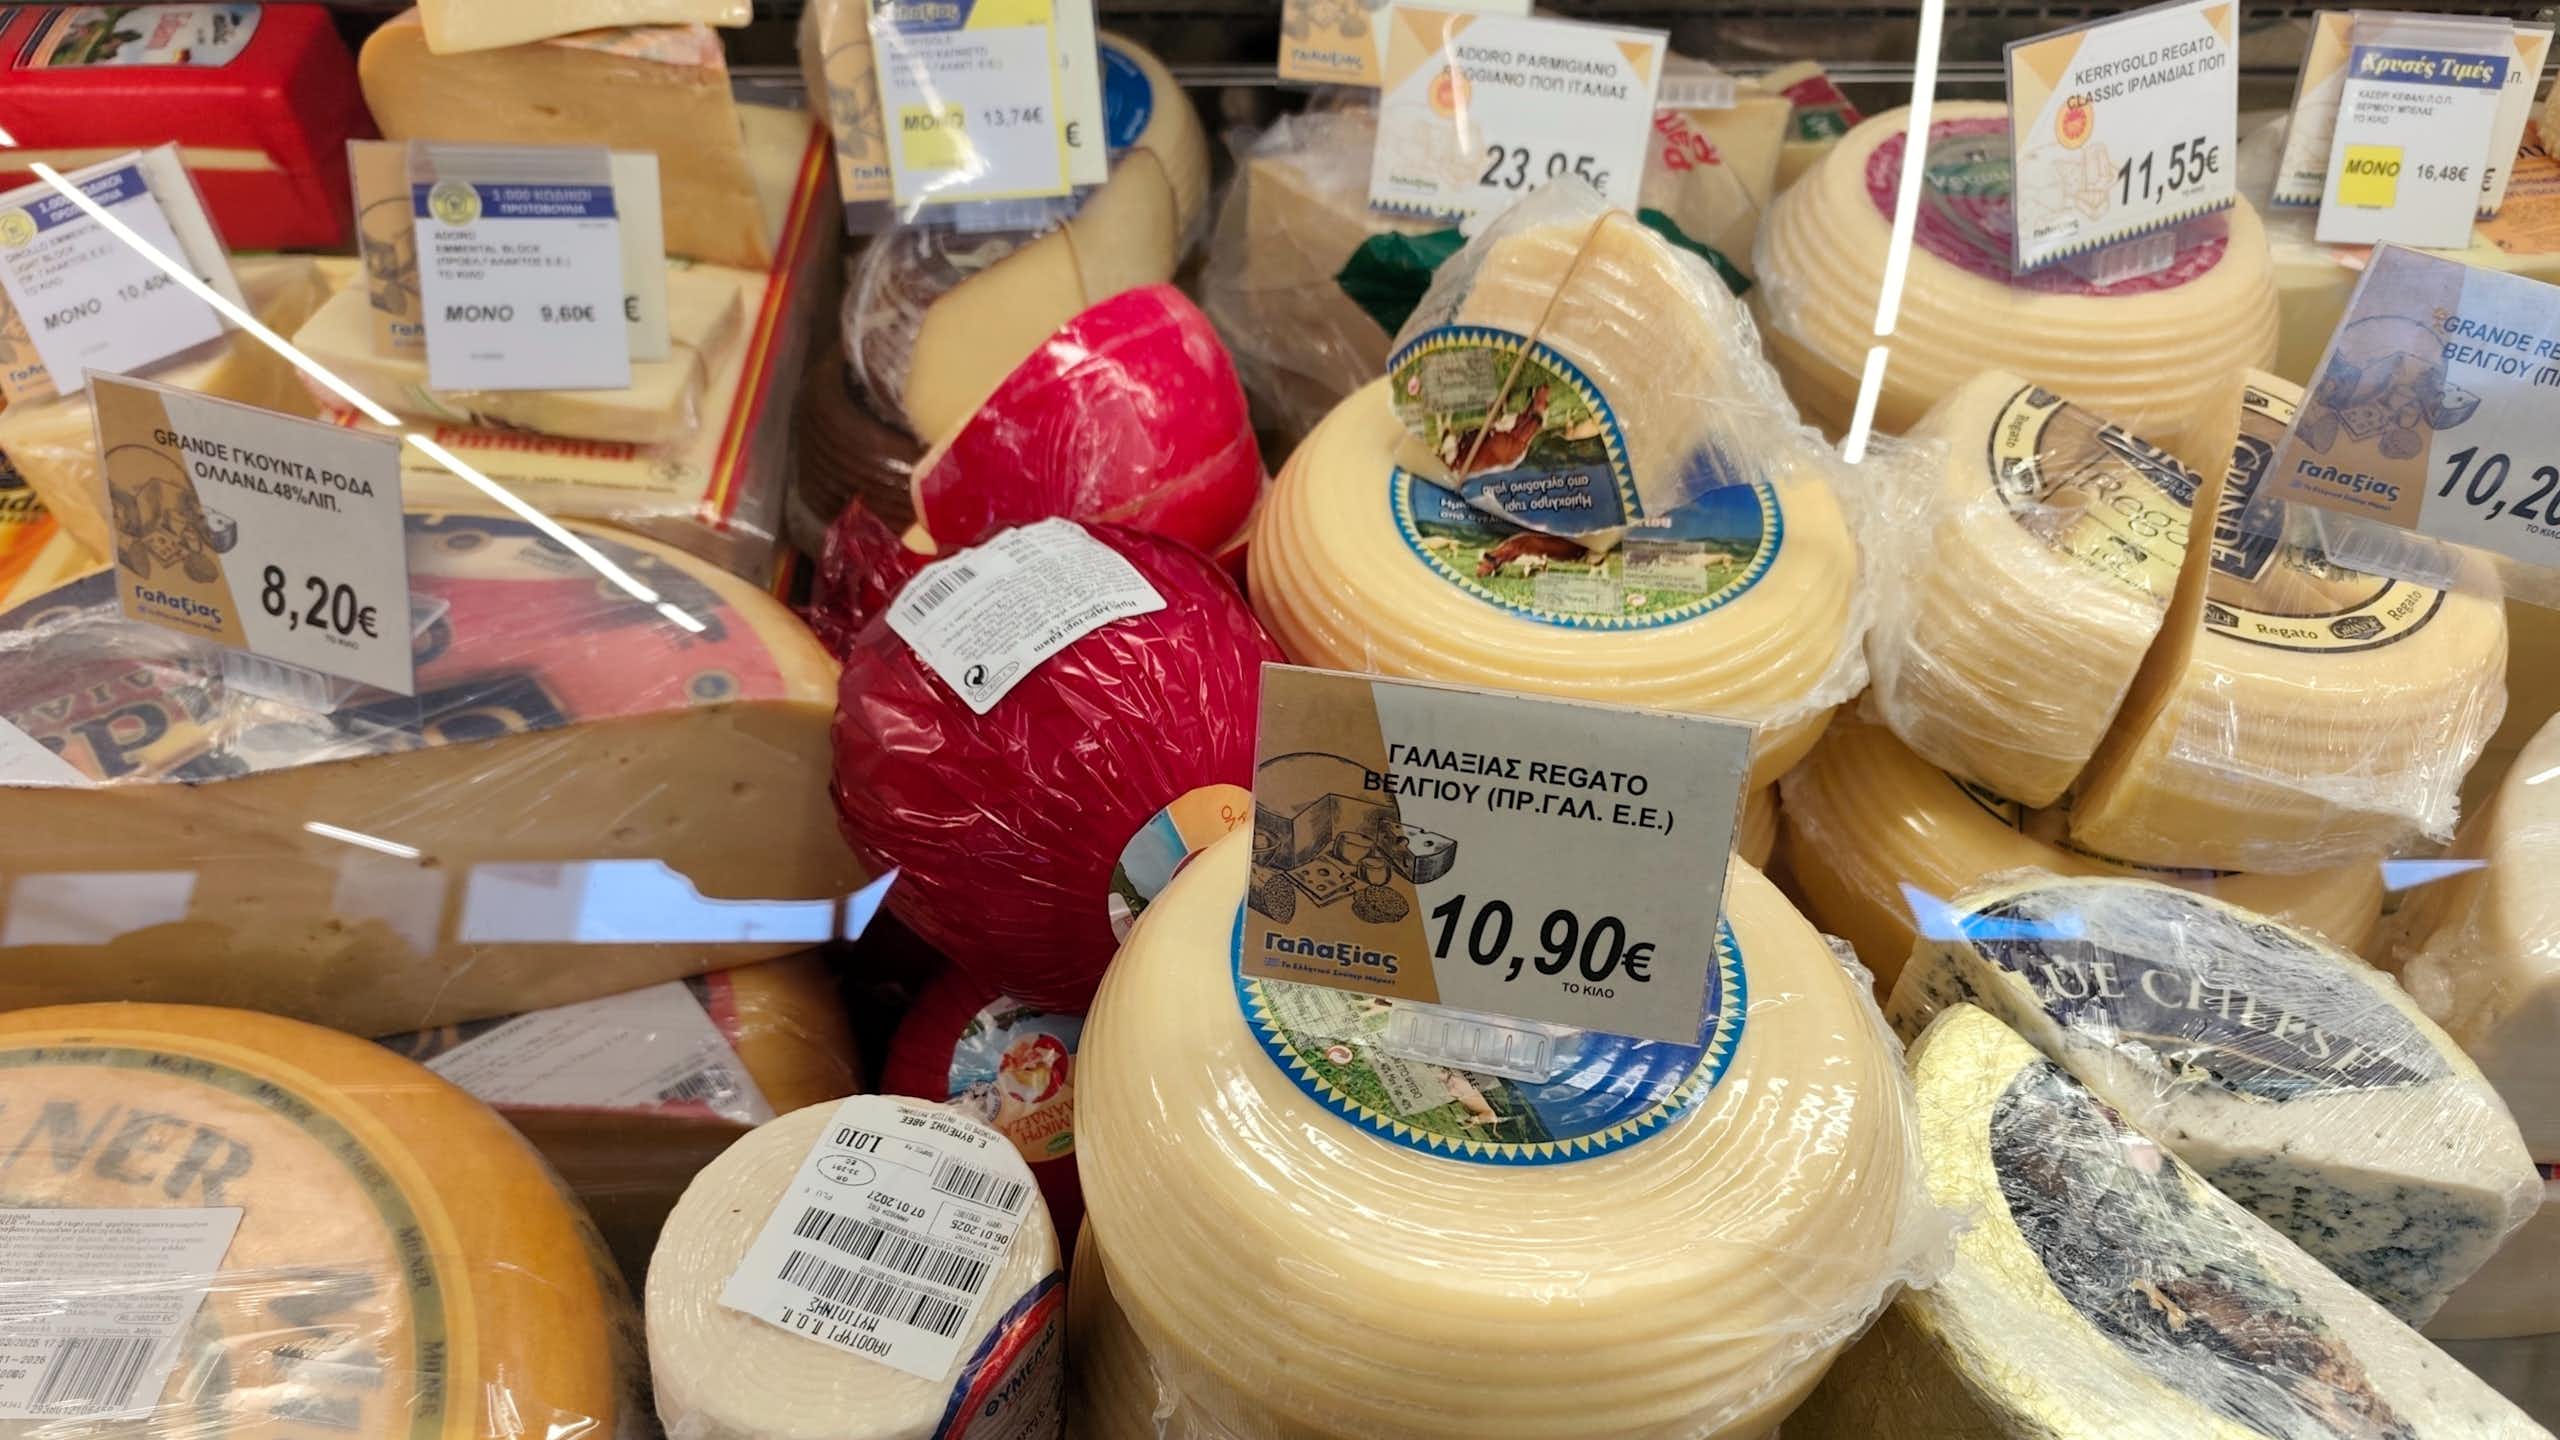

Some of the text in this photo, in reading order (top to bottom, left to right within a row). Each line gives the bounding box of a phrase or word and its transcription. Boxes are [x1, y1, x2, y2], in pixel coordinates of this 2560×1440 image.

[1443, 64, 1526, 87] RGGIANO
[1456, 47, 1617, 79] ADORO PARMIGIANO
[2075, 36, 2215, 87] KERRYGOLD REGATO
[2440, 58, 2496, 83] Τιμές
[2066, 53, 2226, 111] CLASSIC ΙΡΛΑΝΔΙΑΣ ΠΟΠ
[983, 107, 1044, 129] 13,74€
[2117, 136, 2220, 206] 11,55€
[2344, 159, 2401, 178] ΜΟΝΟ
[2416, 163, 2470, 183] 16,48€
[445, 304, 597, 323] ΜΟΝΟ 9,60€
[2442, 315, 2534, 352] GRANDE
[2441, 341, 2534, 379] ΒΕΛΓΙΟΥ
[154, 428, 229, 463] GRANDE
[232, 447, 317, 485] ΓΚΟΥΝΤΑ
[321, 469, 375, 499] ΡΟΔΑ
[260, 563, 379, 640] 8,20€
[2387, 590, 2423, 622] Regato
[1032, 630, 1064, 653] Edam
[2255, 622, 2319, 641] Regato
[1388, 743, 1649, 797] ΓΑΛΑΞΙΑΣ REGATO
[1363, 769, 1676, 836] ΒΕΛΓΙΟΥ (ΠΡ.ΓΑΛ. Ε.Ε.)
[1265, 932, 1399, 974] Γαλαξίας
[1430, 893, 1657, 985] 10,90€
[1561, 981, 1616, 1000] ΤΟ ΚΙΛΟ
[2040, 960, 2126, 1001] UE
[899, 1113, 926, 1129] ΑΒΕΕ
[930, 1120, 975, 1143] ΘΥΜΕΛΗΣ
[1022, 1117, 1073, 1145] ΜΙΚΡΗ
[0, 1099, 254, 1202] NER
[835, 1124, 883, 1155] 1.010
[866, 1190, 926, 1217] 07.01.2027
[950, 1218, 1009, 1244] 06.01.2025
[399, 1225, 432, 1292] MILNER
